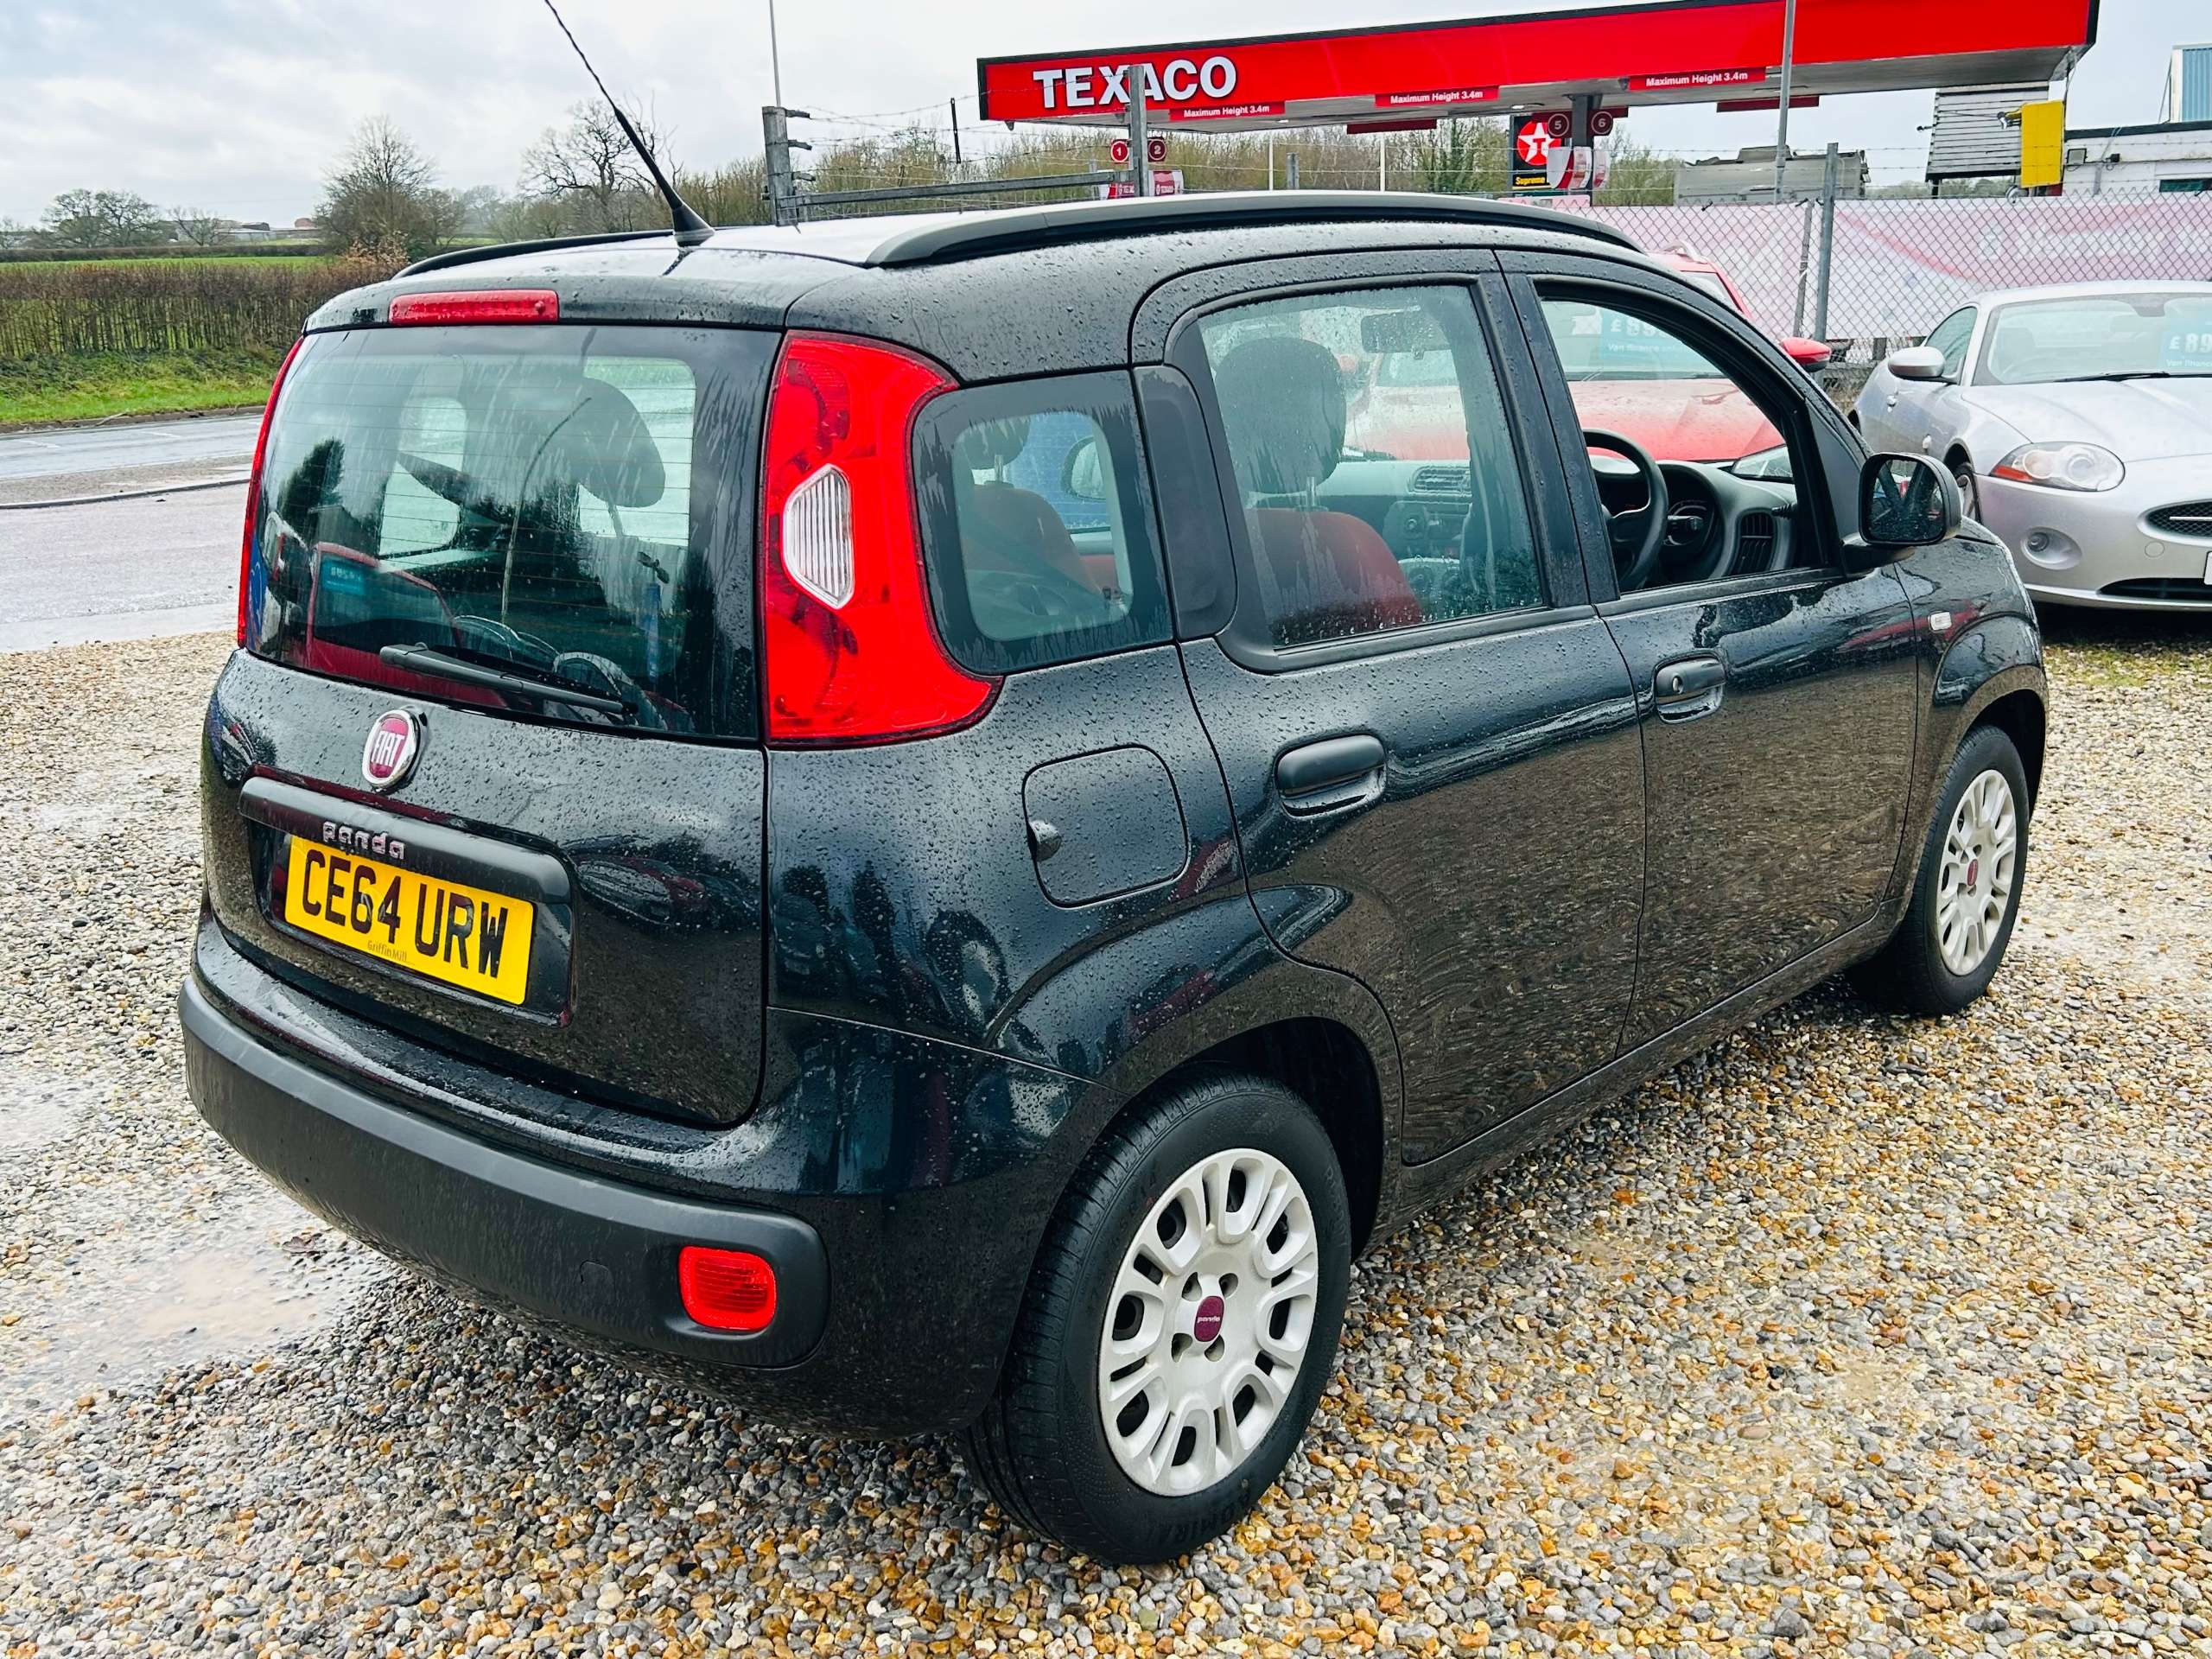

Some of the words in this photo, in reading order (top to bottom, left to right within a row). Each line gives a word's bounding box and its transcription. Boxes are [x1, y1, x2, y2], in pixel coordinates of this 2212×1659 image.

[1033, 55, 1236, 109] TEXACO
[1646, 77, 1690, 86] Maximum
[1691, 73, 1722, 85] Height
[1723, 72, 1748, 81] 3.4m
[1390, 95, 1430, 105] Maximum
[1431, 92, 1460, 102] Height
[1461, 90, 1484, 99] 3.4m
[1184, 108, 1221, 118] Maximum
[1222, 106, 1249, 116] Height
[1249, 105, 1270, 113] 3.4m
[1554, 120, 1562, 130] 5
[1598, 118, 1605, 128] 6
[1116, 147, 1122, 156] 1
[1154, 145, 1162, 155] 2
[1515, 176, 1546, 186] Supreme
[371, 730, 406, 768] FIAT
[322, 821, 405, 860] panda
[302, 849, 402, 944] CE64
[414, 883, 509, 979] URW
